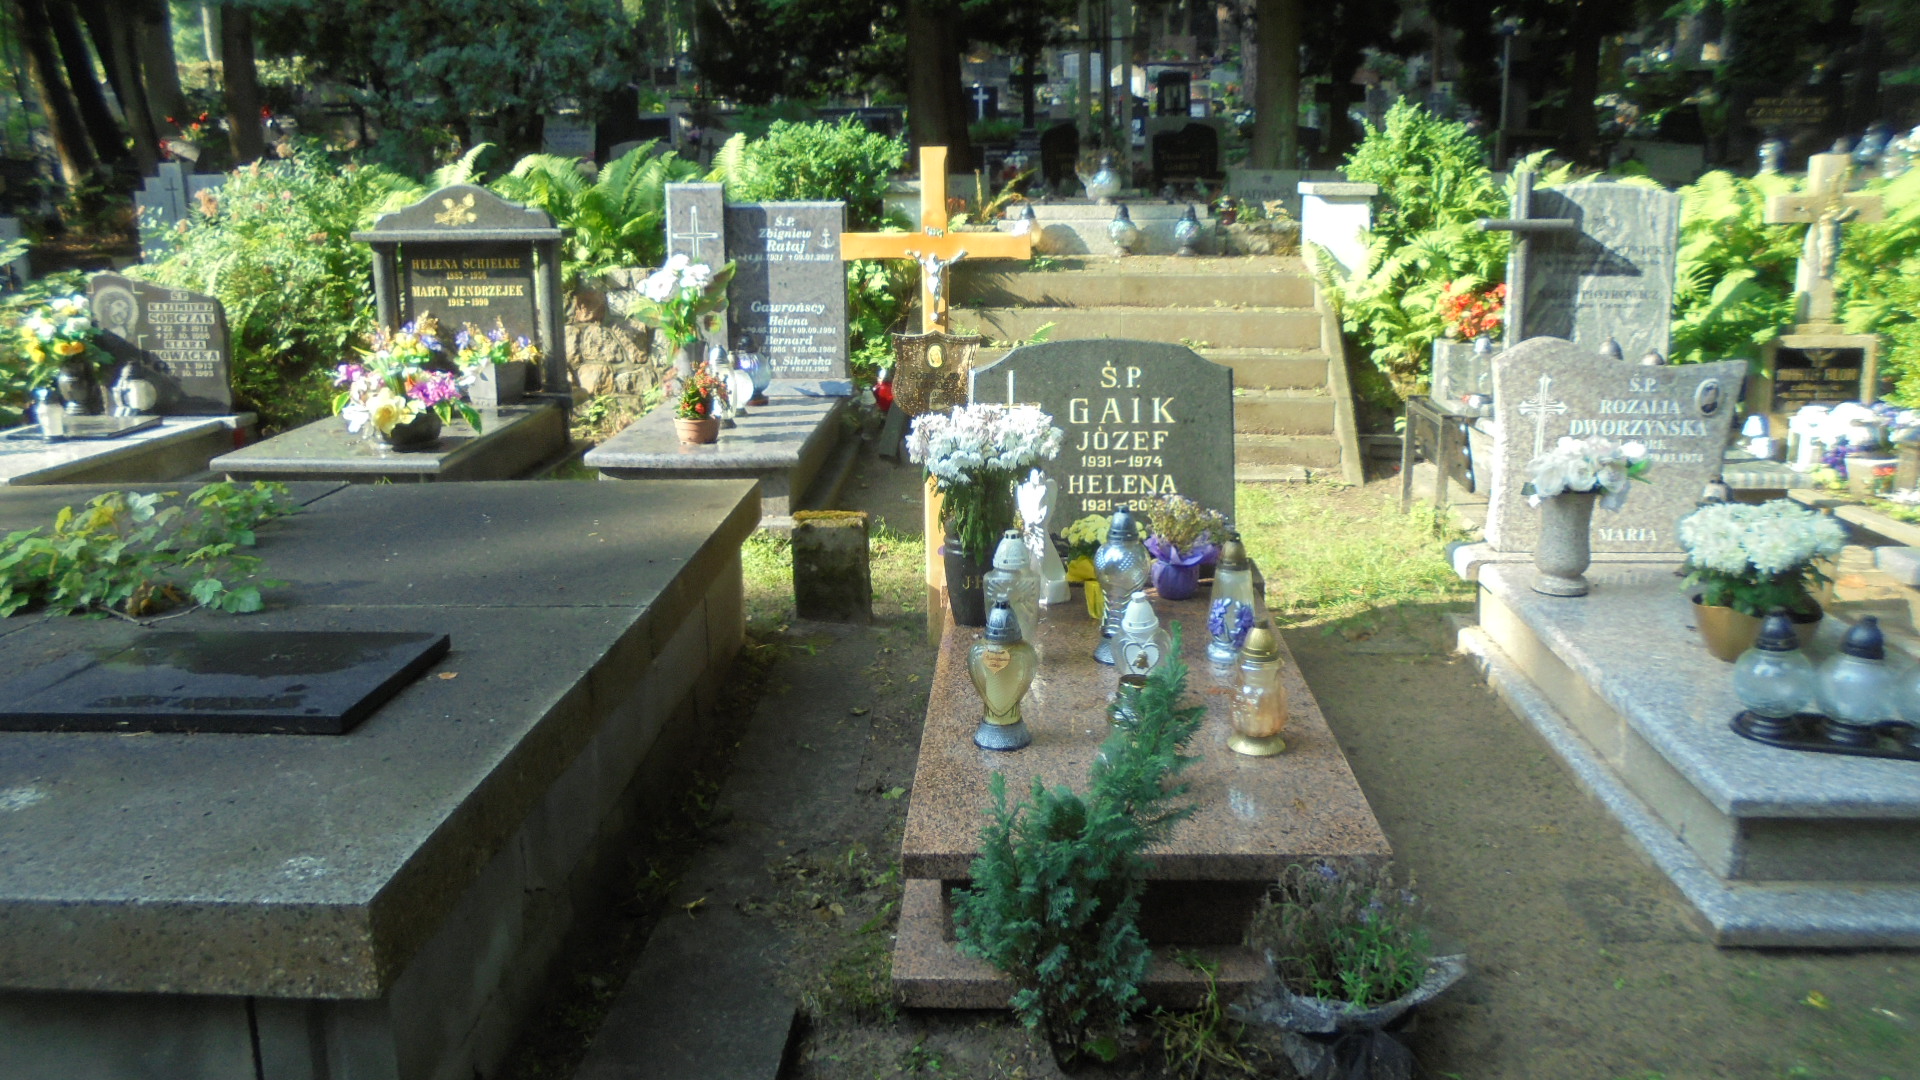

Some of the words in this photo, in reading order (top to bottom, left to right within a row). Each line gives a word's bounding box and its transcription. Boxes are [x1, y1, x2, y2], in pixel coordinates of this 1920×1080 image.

[759, 228, 812, 240] Zbigniew
[767, 239, 806, 254] Rataj
[412, 259, 458, 270] HELENA
[462, 259, 521, 269] SCHIELKE
[411, 285, 449, 297] MARTA
[452, 285, 524, 296] JENDRZEJEK
[750, 301, 825, 315] Gawrońscy
[148, 312, 215, 324] SOBCZAK
[768, 315, 808, 326] Helena
[765, 335, 813, 345] Bernard
[782, 356, 832, 366] Sikorska
[1069, 397, 1176, 424] GAIK
[1599, 399, 1681, 414] ROZALIA
[1568, 416, 1708, 437] DWORZYŃSKA
[1076, 426, 1169, 451] JÓZEF
[1067, 474, 1177, 495] HELENA
[1598, 528, 1657, 542] MARIA
